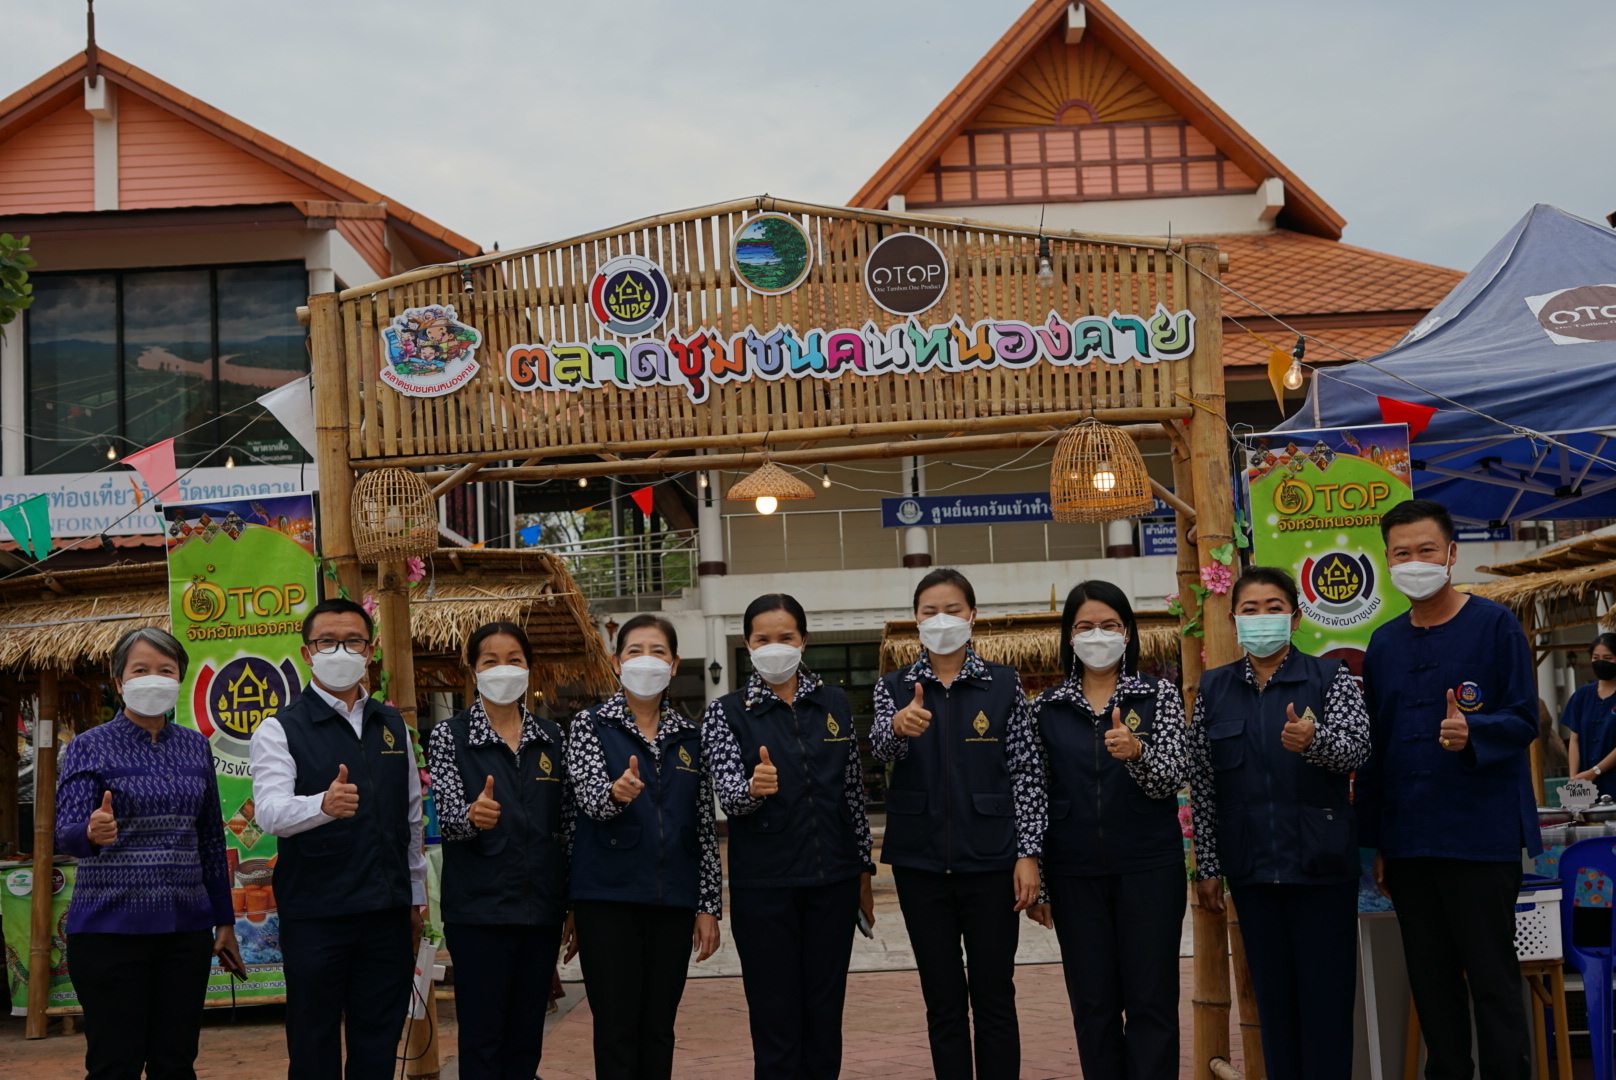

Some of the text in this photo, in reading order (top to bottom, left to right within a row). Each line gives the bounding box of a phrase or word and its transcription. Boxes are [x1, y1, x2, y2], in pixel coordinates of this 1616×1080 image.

[872, 264, 941, 285] OTOP
[920, 283, 941, 291] Product
[509, 309, 1195, 402] ตลาดชุมชนคนหนองคาย
[384, 363, 476, 394] ตลาดชุมชนคนหนองคาย
[1273, 478, 1390, 515] OTOP
[1277, 514, 1384, 531] จังหวัดหนองคา
[182, 580, 306, 622] OTOP
[1299, 596, 1381, 626] กรมการพัฒนาชุมชน
